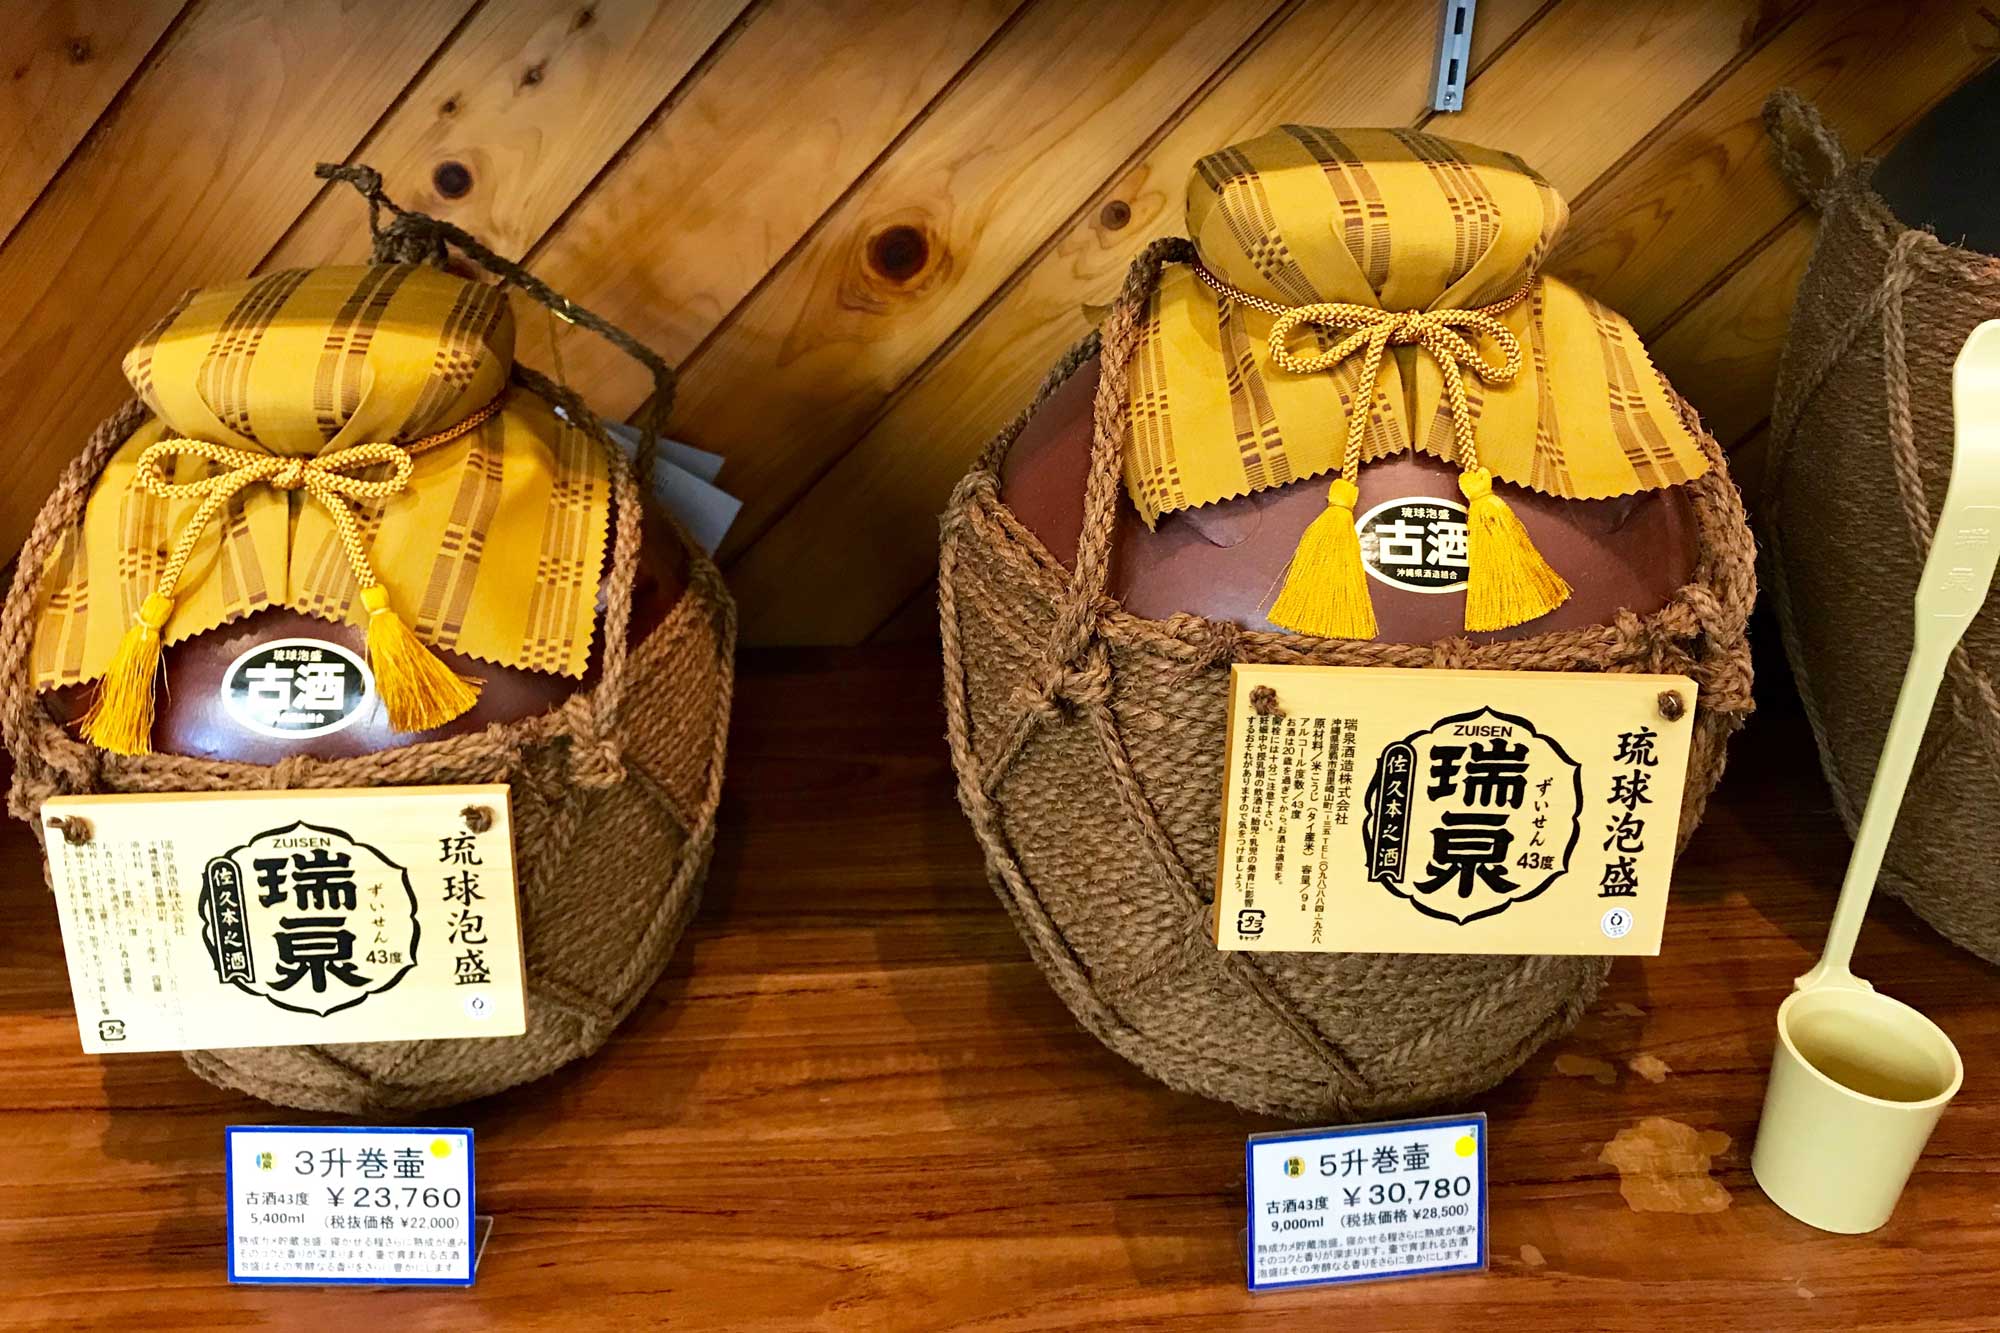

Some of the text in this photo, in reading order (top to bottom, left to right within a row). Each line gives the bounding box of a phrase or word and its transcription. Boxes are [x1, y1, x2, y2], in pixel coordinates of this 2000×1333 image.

[1401, 507, 1450, 520] 琉球泡盛
[1375, 519, 1469, 567] 古酒
[1396, 568, 1458, 580] 沖縄県酒造組合
[273, 649, 322, 662] 琉球泡盛
[245, 662, 346, 711] 古酒
[1453, 724, 1513, 738] ZUISEN
[1334, 718, 1358, 825] 瑞泉酒造株式会社
[1378, 756, 1409, 868] 佐久本之酒
[1530, 777, 1554, 847] ずいせん
[1598, 725, 1659, 899] 琉球泡盛
[272, 838, 331, 849] ZUISEN
[1516, 851, 1555, 871] 43度
[367, 883, 389, 945] ずいせん
[438, 831, 491, 985] 琉球泡盛
[213, 867, 246, 971] 佐久本之酒
[1244, 915, 1263, 928] プラ
[365, 950, 403, 965] 43度
[245, 1191, 310, 1207] 古酒43度
[1266, 1195, 1329, 1215] 古酒43度
[249, 1212, 306, 1225] 5,400ml
[1271, 1217, 1324, 1233] 9,000ml
